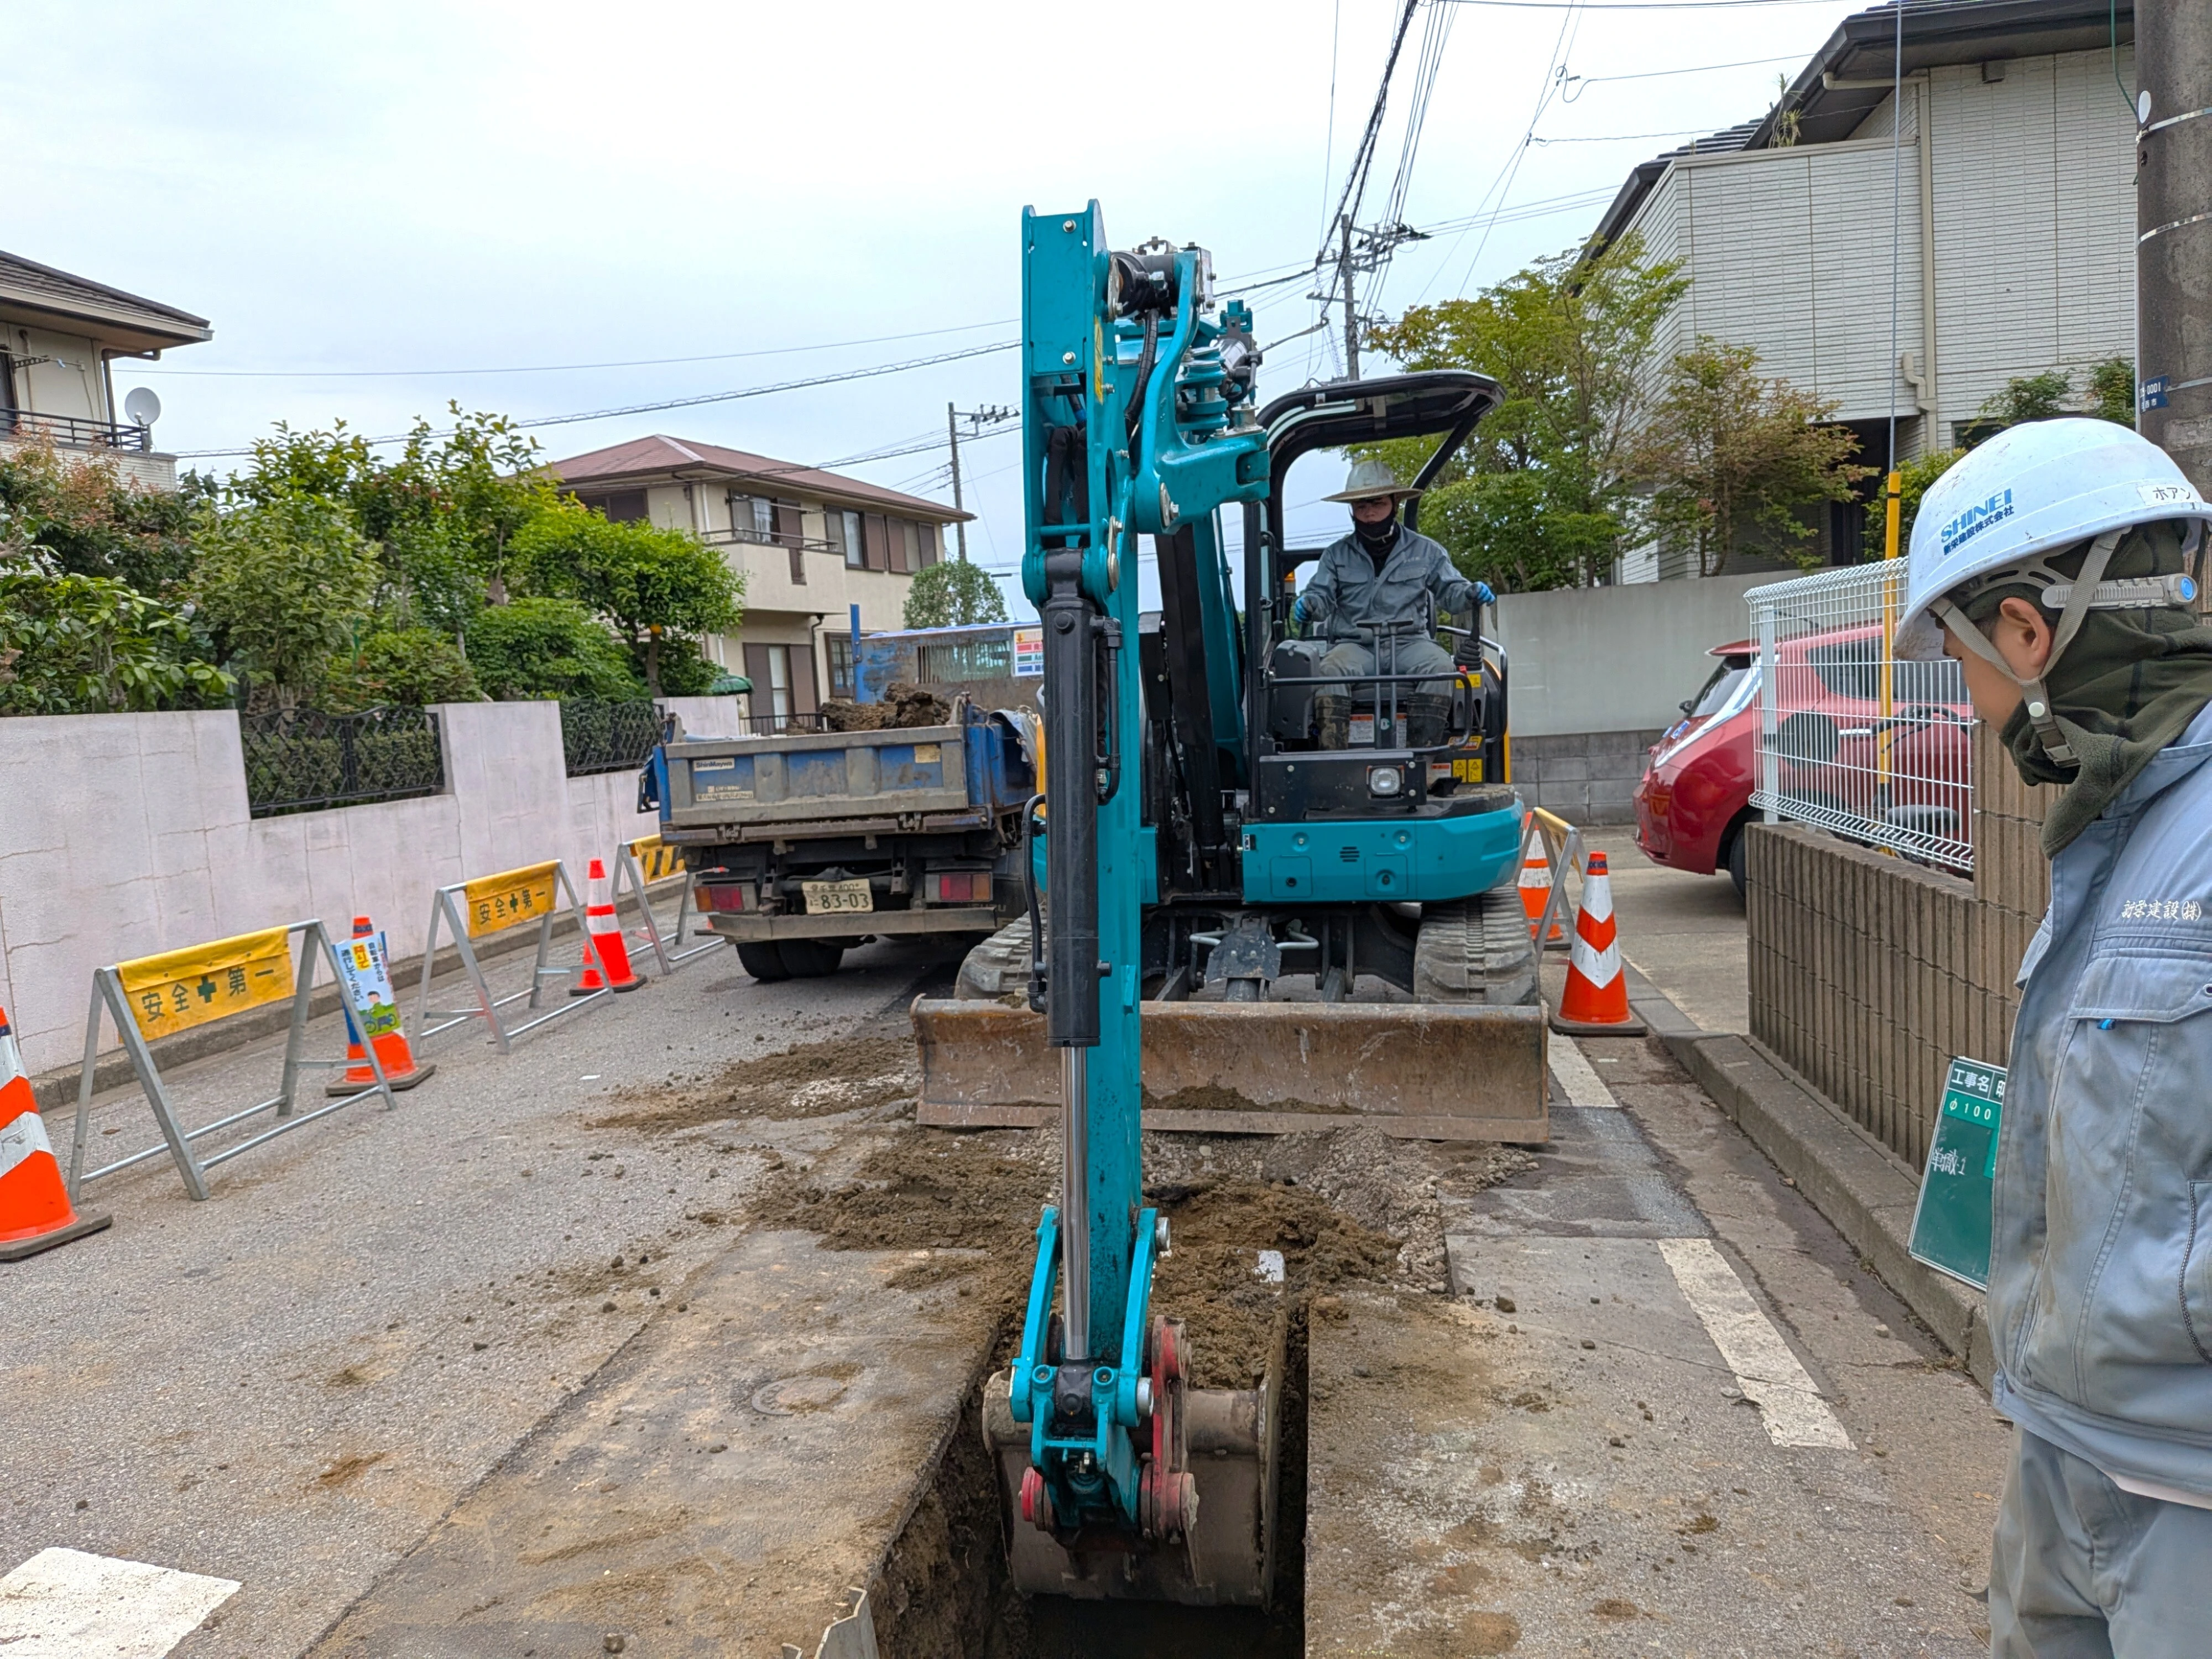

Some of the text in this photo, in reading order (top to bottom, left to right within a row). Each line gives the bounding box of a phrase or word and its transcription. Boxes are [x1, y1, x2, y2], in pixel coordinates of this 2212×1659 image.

[2152, 487, 2190, 500] ホアン
[1941, 488, 2011, 543] SHINEI
[1943, 505, 2014, 555] 新栄建設株式会社
[479, 889, 546, 925] 安全 第一
[821, 893, 869, 909] 83-03
[141, 966, 274, 1022] 安全 第一
[1951, 1068, 1990, 1093] 工事名
